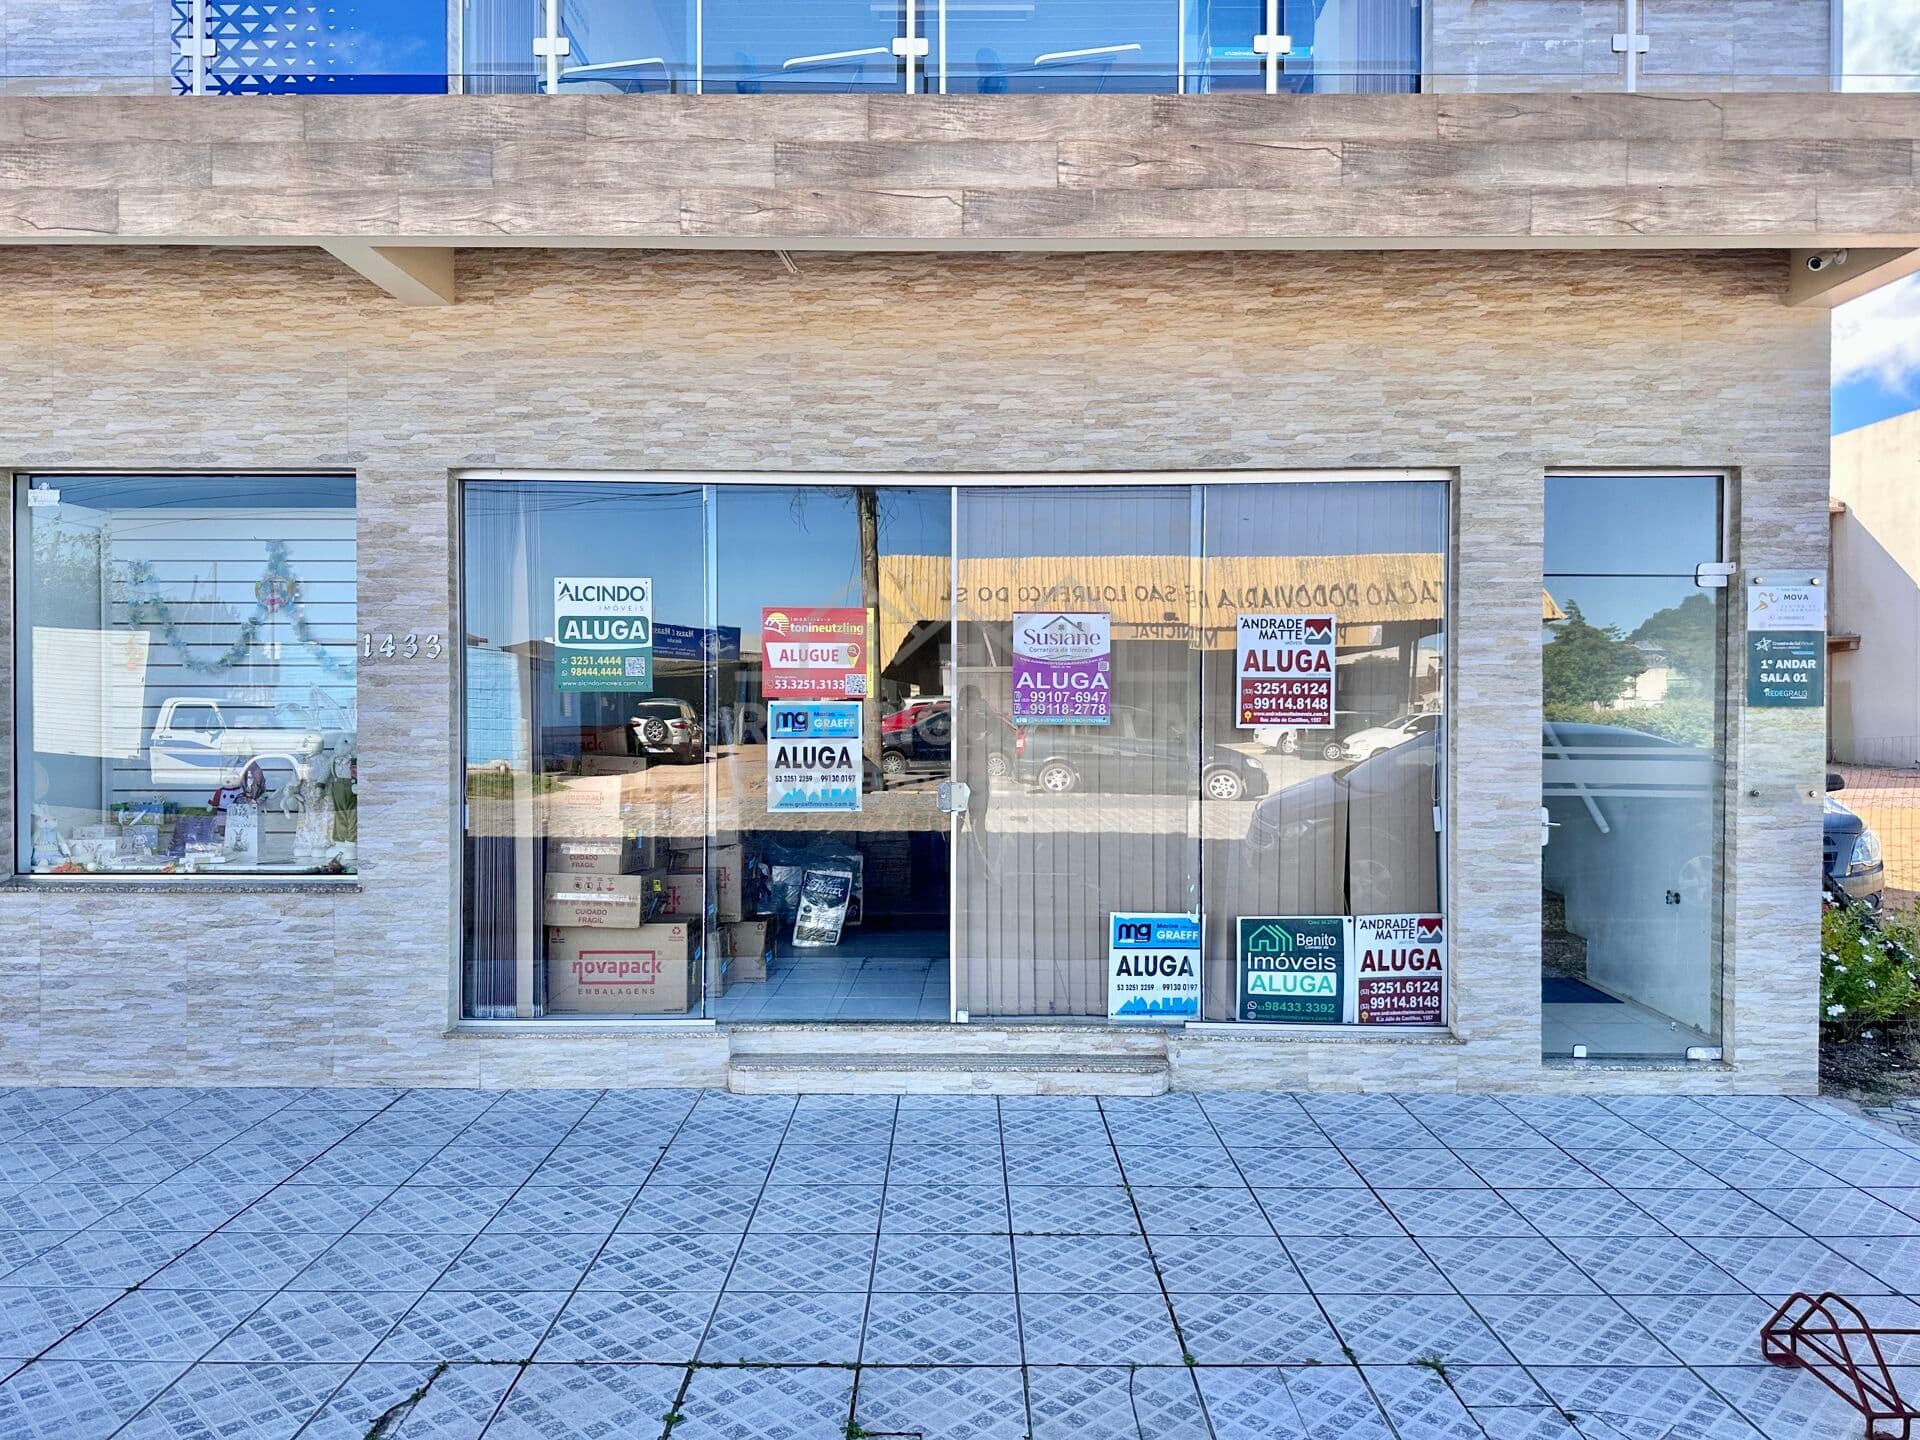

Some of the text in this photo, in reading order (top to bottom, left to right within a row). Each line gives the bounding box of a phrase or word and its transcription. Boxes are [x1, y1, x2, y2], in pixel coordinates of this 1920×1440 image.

[558, 583, 646, 602] ALCINDO
[564, 620, 646, 640] ALUGA
[790, 622, 864, 635] tonineutzling
[1241, 618, 1303, 630] ANDRADE
[1023, 629, 1101, 646] Susiane
[1258, 630, 1303, 640] MATTE
[362, 633, 442, 660] 1433
[570, 656, 622, 665] 3251.4444
[779, 648, 839, 662] ALUGUE
[1243, 649, 1331, 673] ALUGA
[1776, 659, 1816, 669] ANDAR
[570, 667, 623, 676] 98444.4444
[775, 679, 845, 689] 53.3251.3133
[1016, 672, 1109, 689] ALUGA
[1760, 673, 1808, 683] SALA 01
[1254, 683, 1327, 695] 3251.6124
[1030, 691, 1108, 703] 99107-6947
[1030, 703, 1107, 715] 99118-2778
[1254, 697, 1328, 710] 99114.8148
[814, 718, 855, 728] GRAEFF
[775, 746, 853, 769] ALUGA
[775, 775, 783, 783] 53
[575, 908, 608, 916] CUIDADO
[1359, 918, 1416, 929] ANDRADE
[1156, 930, 1198, 940] GRAEFF
[1296, 933, 1337, 946] Benito
[1375, 929, 1415, 940] MATTE
[1116, 955, 1194, 977] ALUGA
[1247, 952, 1337, 970] Imóveis
[1360, 949, 1442, 972] ALUGA
[572, 959, 662, 978] novapack
[1250, 975, 1334, 993] ALUGA
[1370, 982, 1439, 994] 3251.6124
[1264, 1001, 1335, 1013] 98433.3392
[1370, 996, 1439, 1009] 99114.8148
